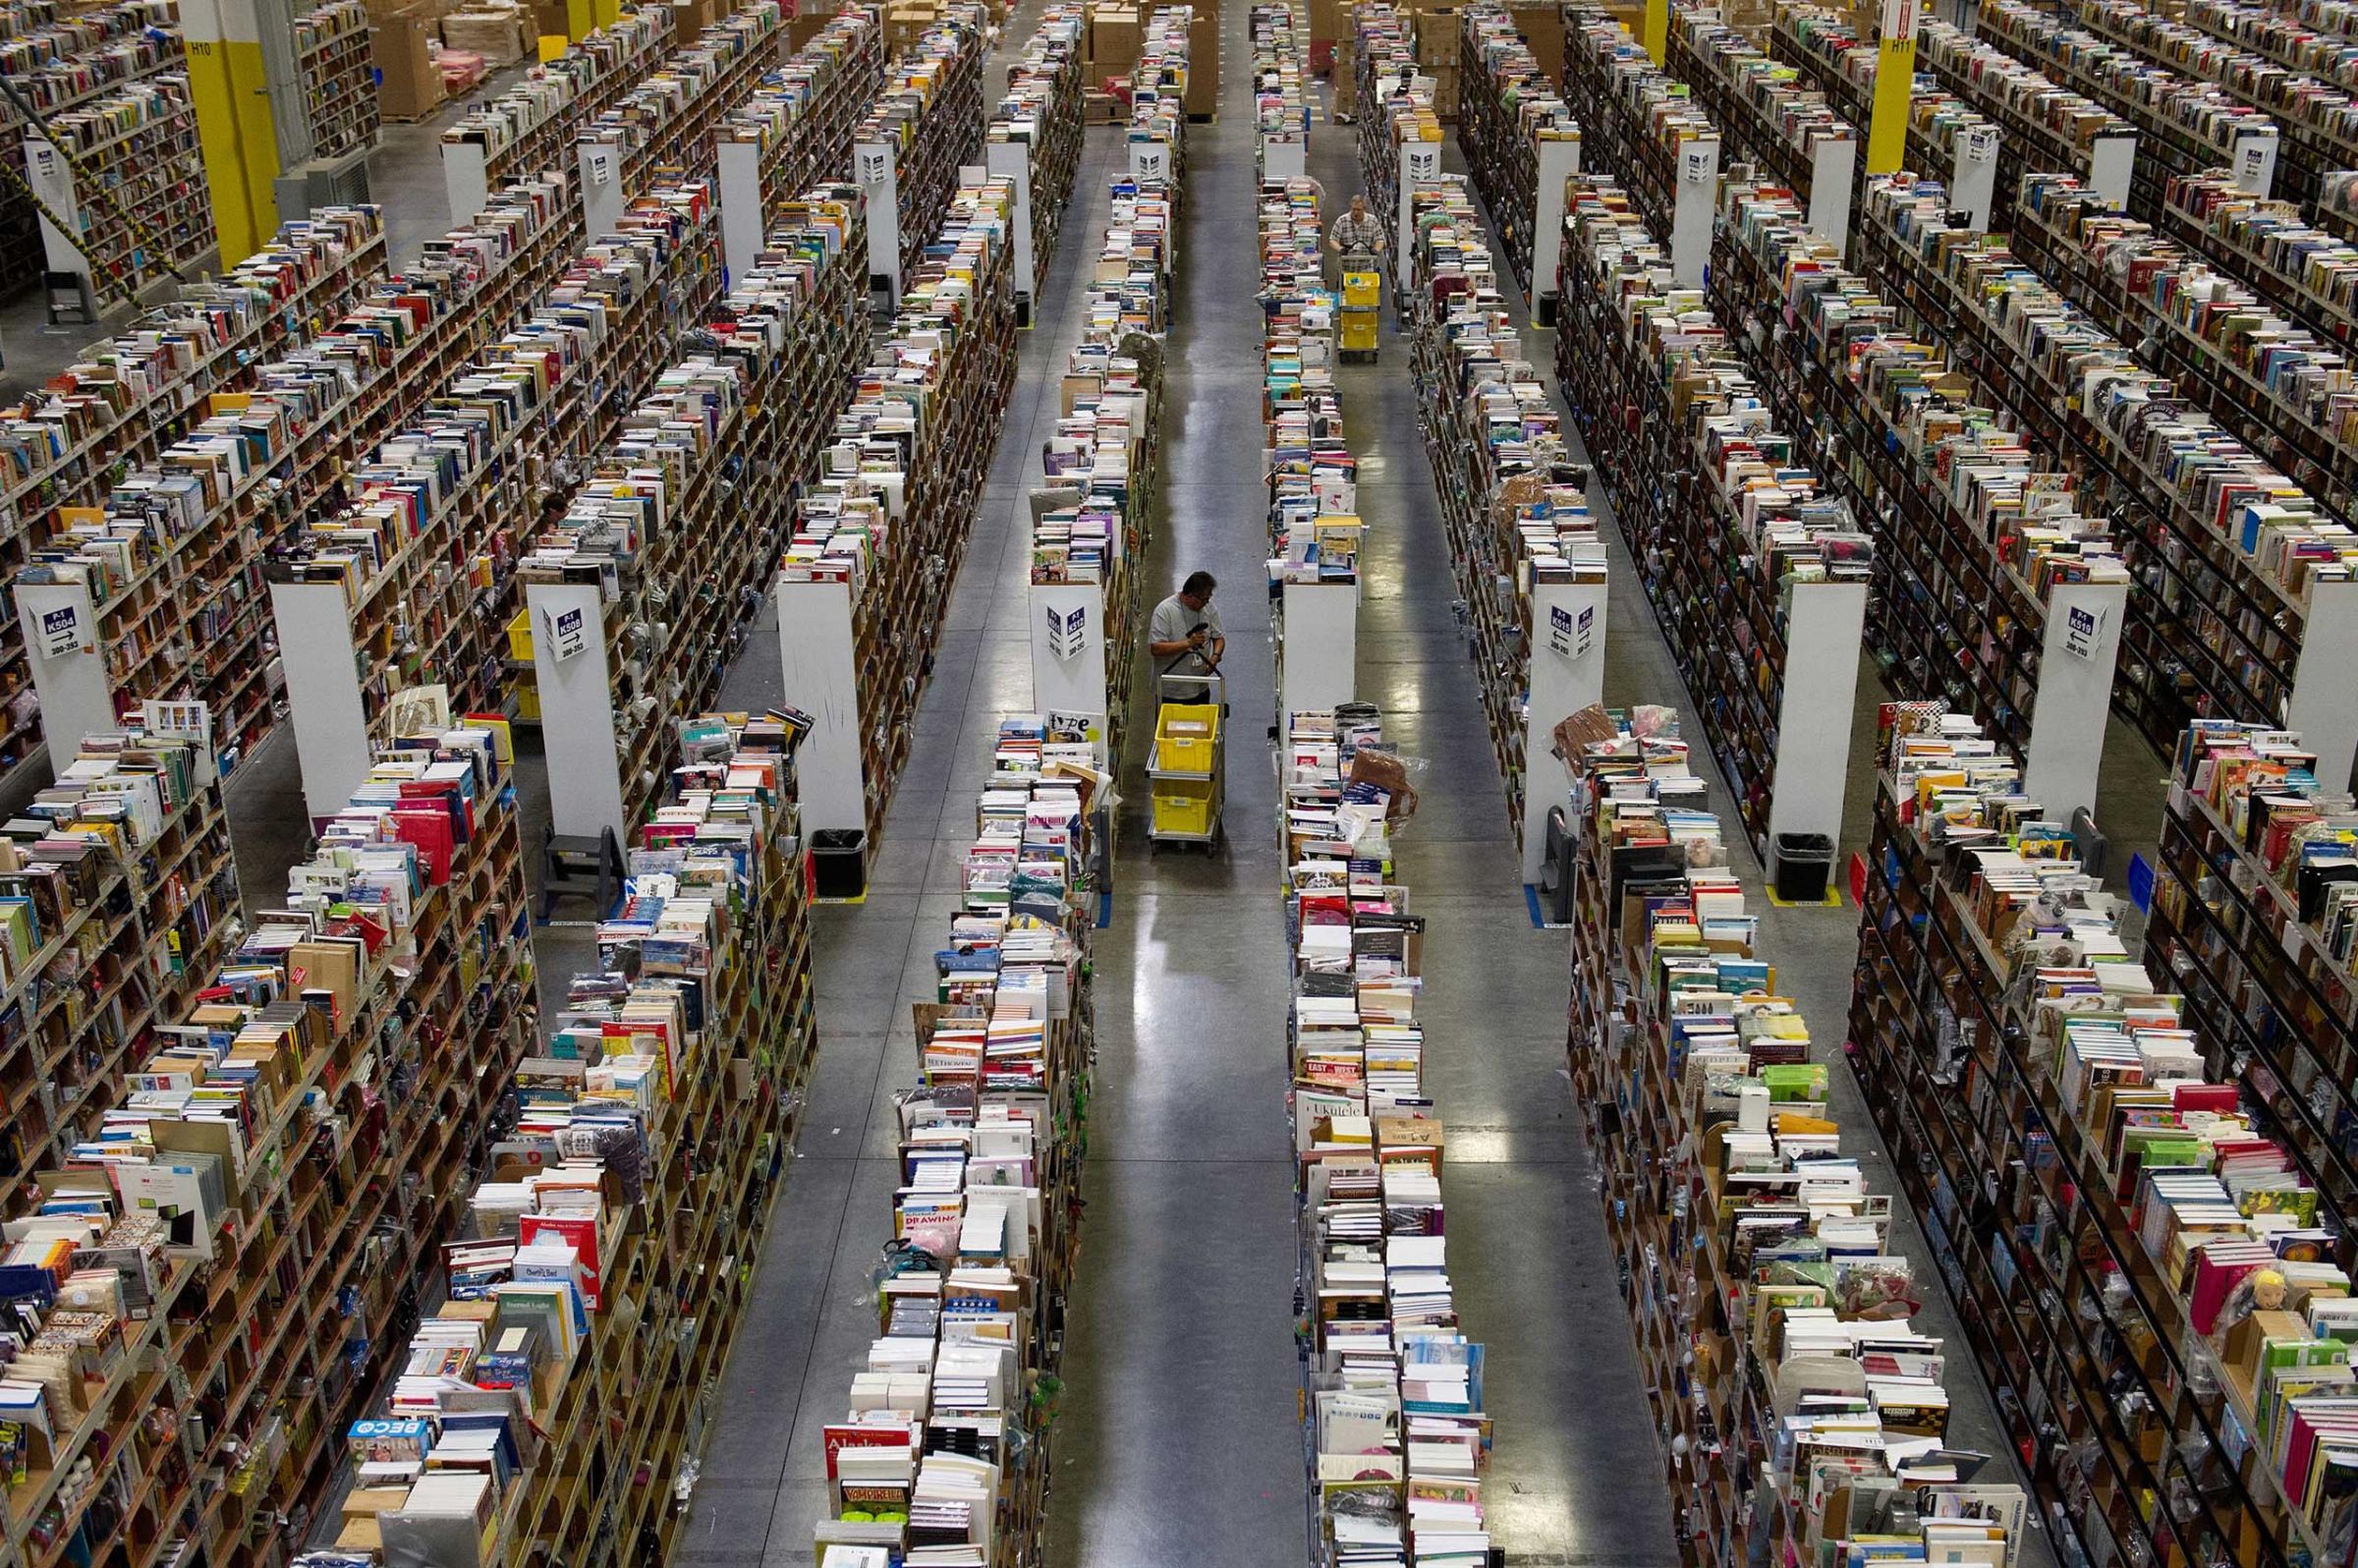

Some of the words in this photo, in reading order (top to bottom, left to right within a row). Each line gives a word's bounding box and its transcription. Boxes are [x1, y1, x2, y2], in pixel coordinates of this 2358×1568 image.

[192, 42, 211, 56] H10
[1892, 40, 1910, 54] H11
[53, 611, 66, 620] P-1
[564, 612, 574, 622] P-1
[2077, 611, 2087, 621] P-1
[47, 617, 75, 633] K504
[1552, 616, 1570, 633] K515
[2070, 617, 2092, 634] K519
[1050, 713, 1090, 732] type
[1308, 1063, 1326, 1072] EAST
[1314, 1103, 1360, 1117] Ukulele
[358, 1422, 422, 1433] BECO
[1801, 1444, 1856, 1459] HOBBIT
[844, 1488, 905, 1502] VAMPIRELLA
